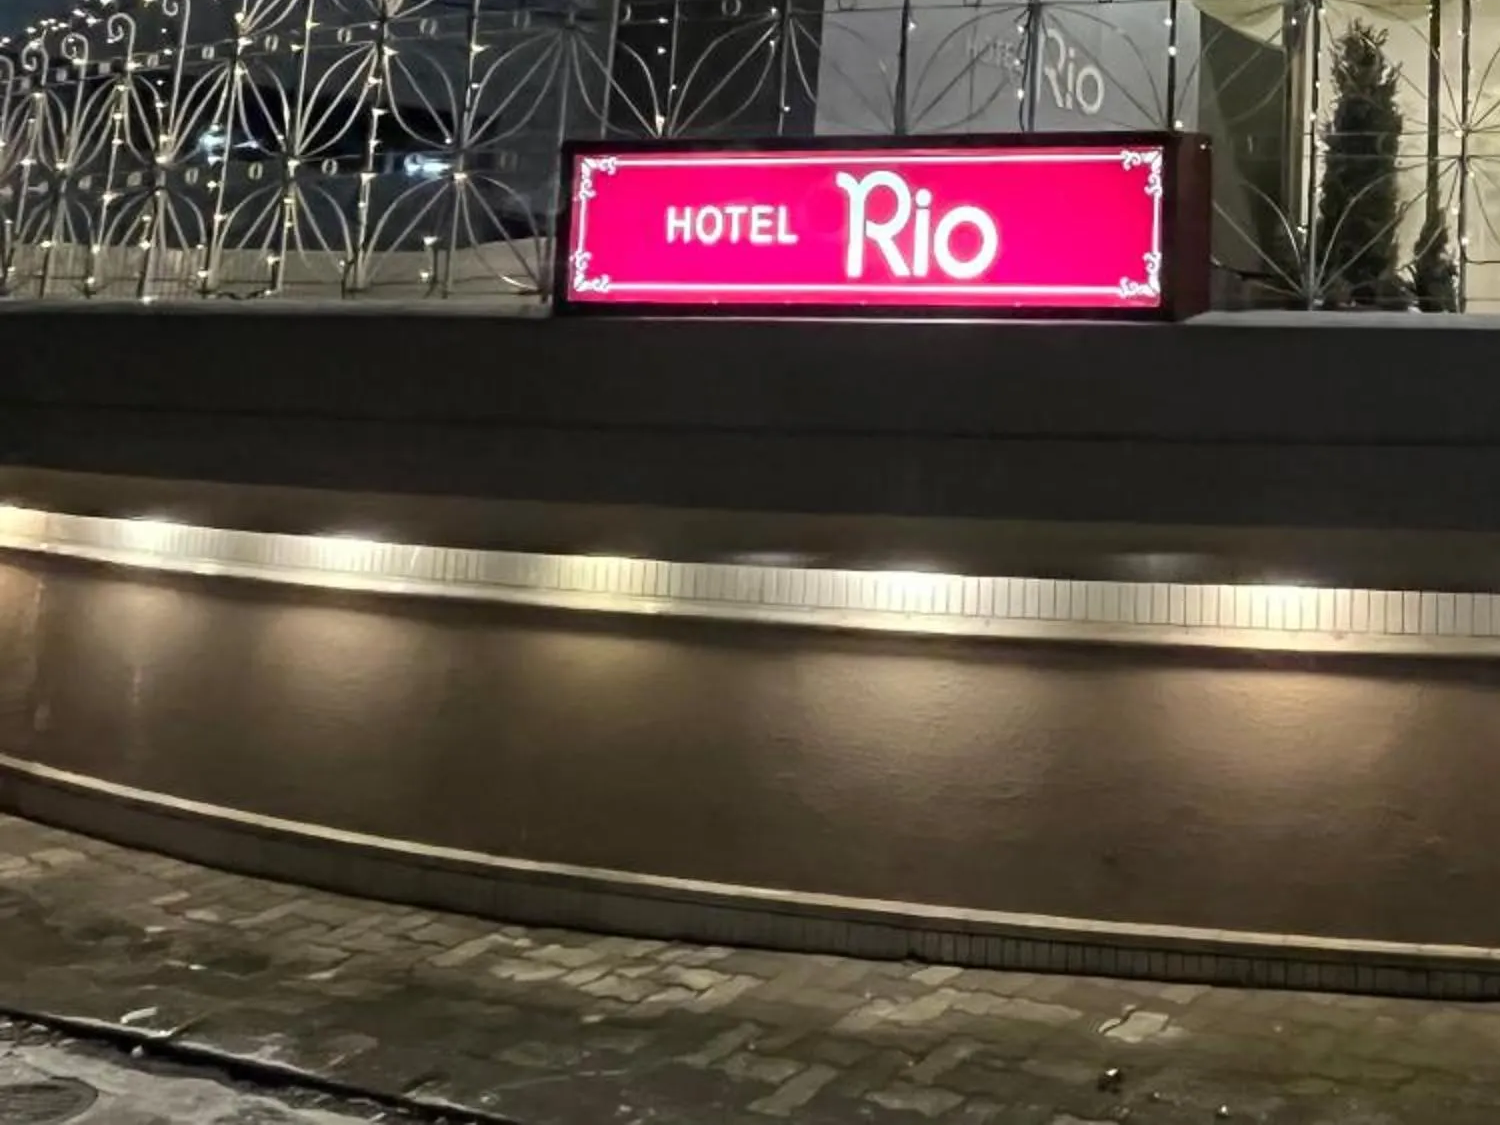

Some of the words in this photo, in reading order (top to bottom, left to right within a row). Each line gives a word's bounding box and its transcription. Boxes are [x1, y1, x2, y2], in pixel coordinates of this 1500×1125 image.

[1034, 27, 1105, 115] Rio
[664, 205, 799, 246] HOTEL
[834, 170, 999, 280] Rio
